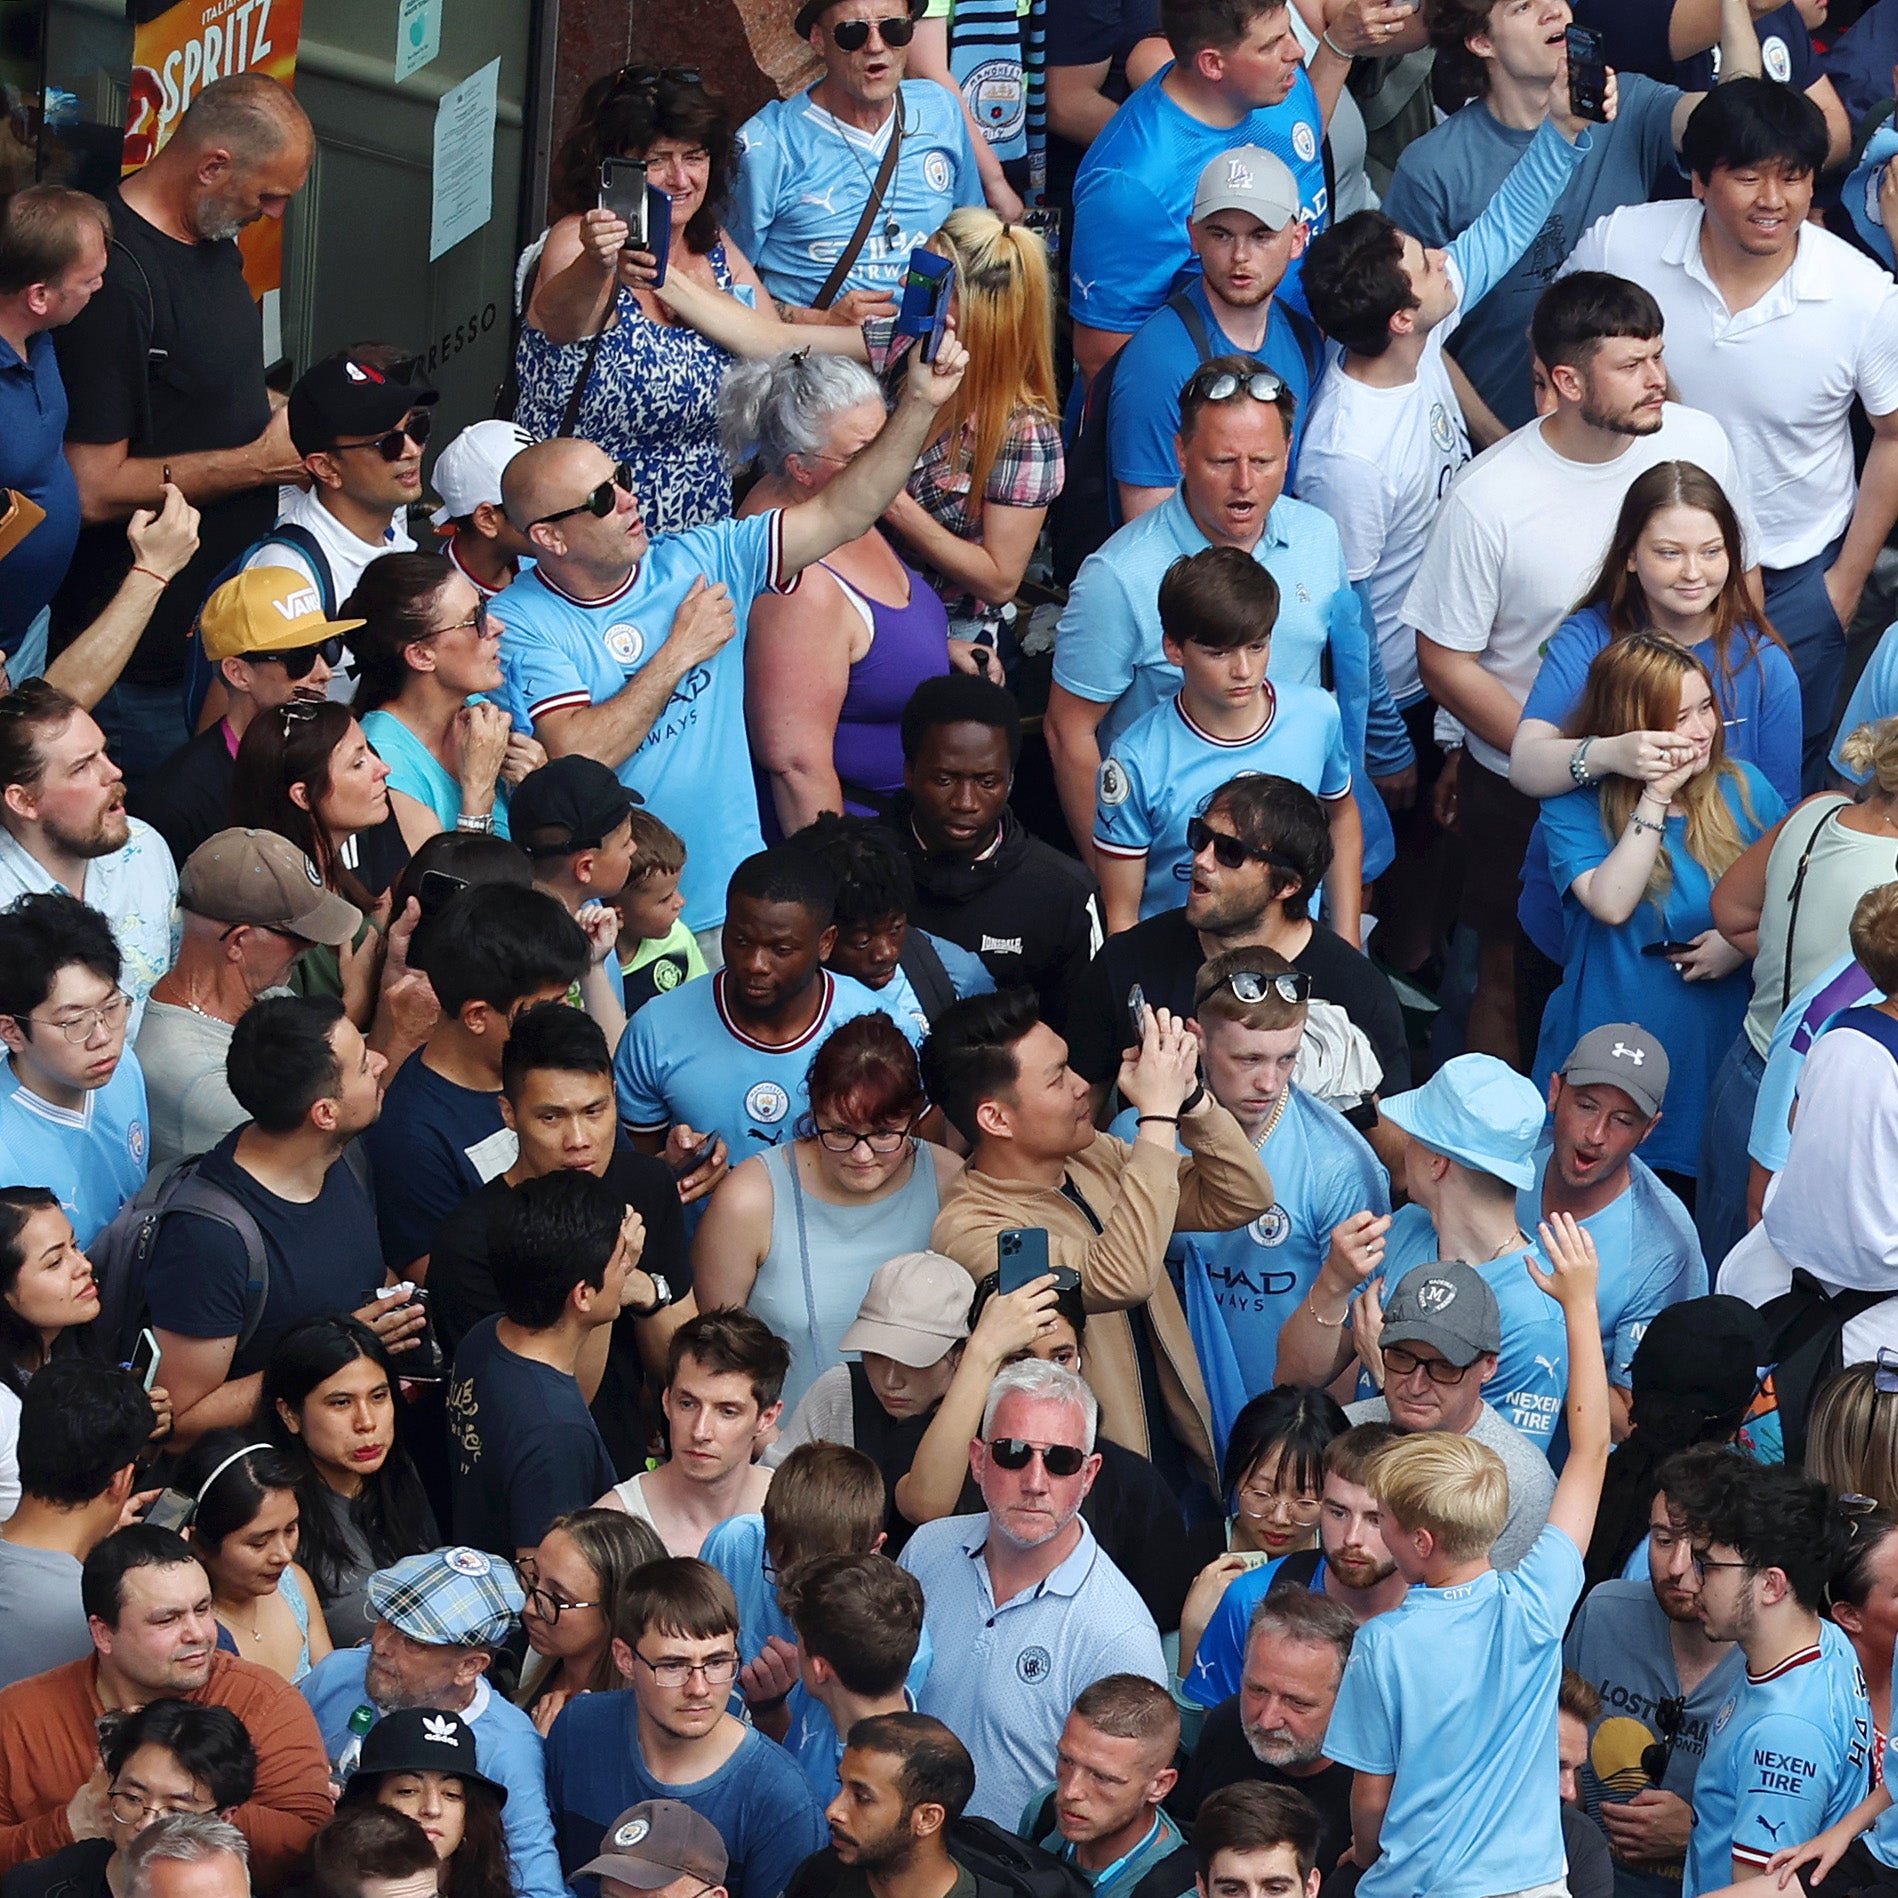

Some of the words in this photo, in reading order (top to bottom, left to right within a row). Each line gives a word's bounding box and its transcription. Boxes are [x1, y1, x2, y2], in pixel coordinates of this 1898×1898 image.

[160, 0, 272, 126] SPRITZ
[1427, 1287, 1443, 1302] M
[1505, 1391, 1560, 1414] NEXEN
[1512, 1408, 1552, 1430] TIRE
[1443, 1585, 1473, 1601] CITY
[423, 1733, 459, 1748] adidas
[1753, 1749, 1816, 1780] NEXEN
[1760, 1770, 1803, 1796] TIRE
